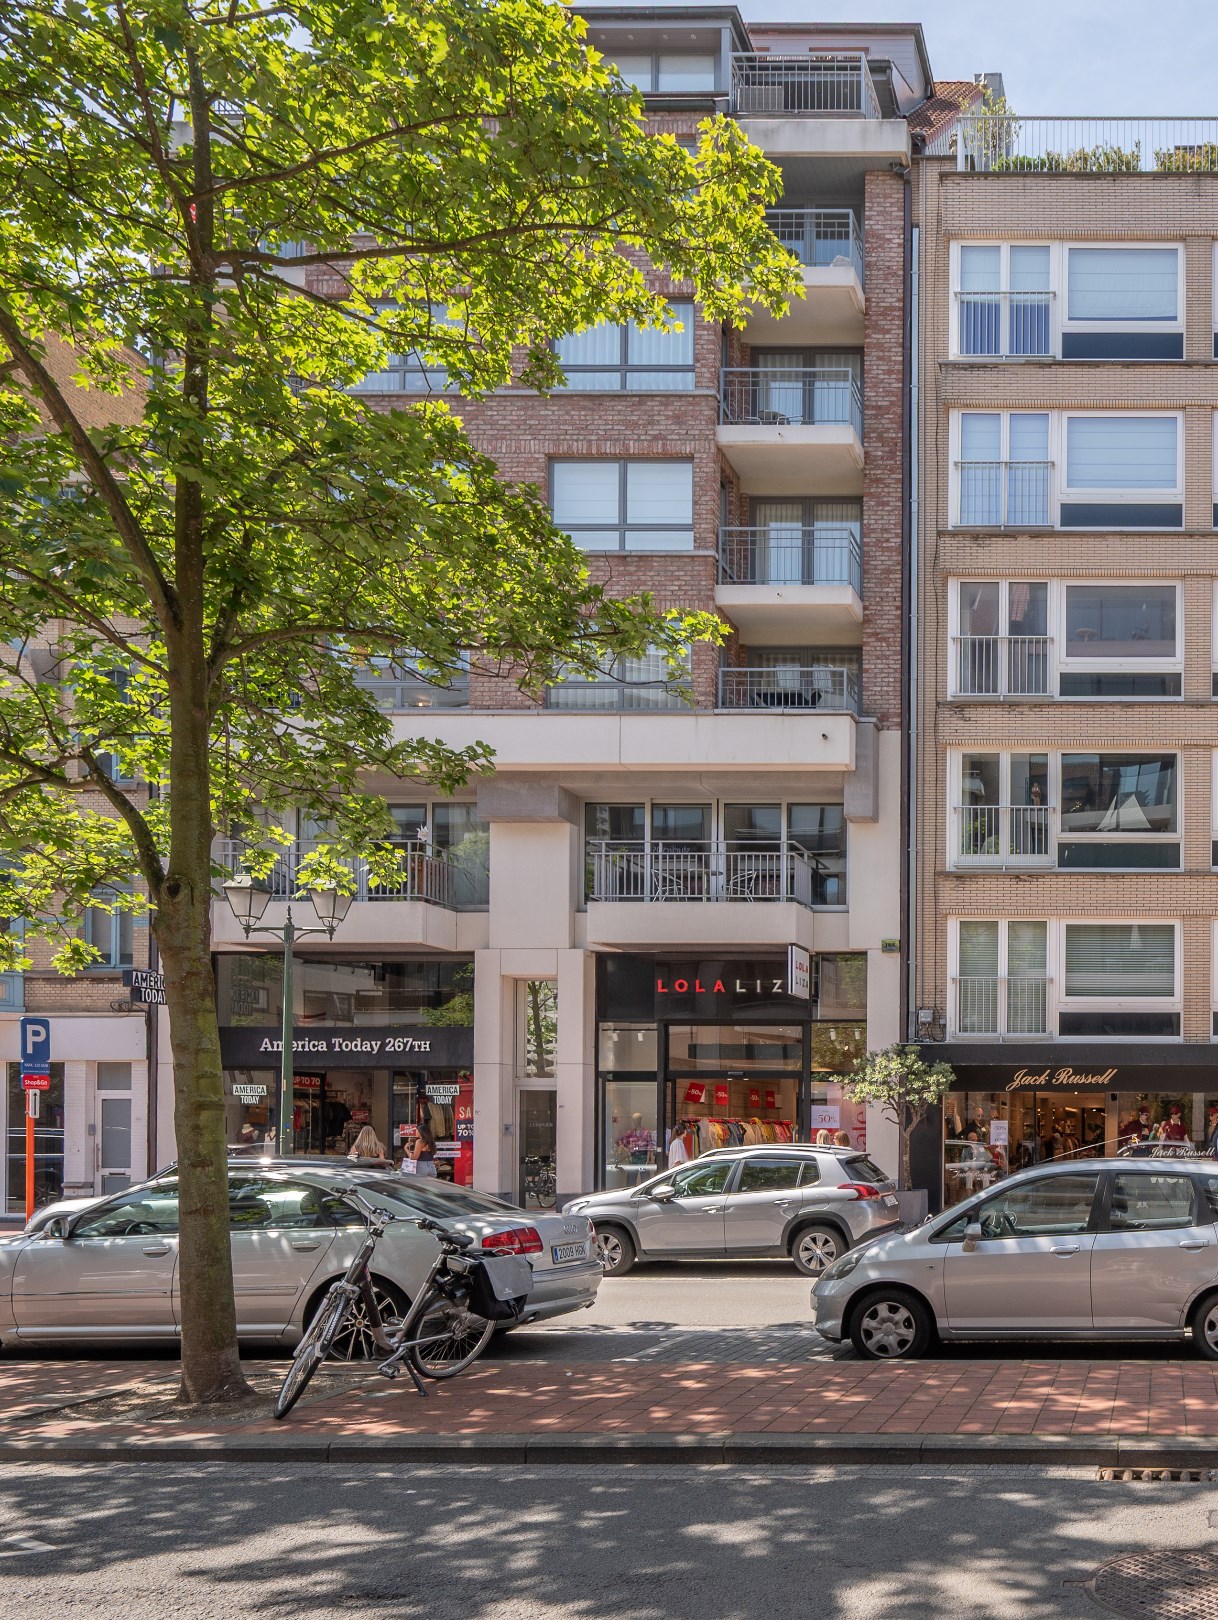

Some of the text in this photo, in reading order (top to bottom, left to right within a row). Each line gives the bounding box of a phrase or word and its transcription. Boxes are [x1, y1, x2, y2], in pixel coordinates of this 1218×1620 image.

[27, 1025, 46, 1054] P
[332, 1038, 381, 1053] Today
[1006, 1067, 1118, 1091] Jack Russell
[234, 1086, 265, 1094] AMERICA
[427, 1086, 458, 1094] AMERICA
[240, 1096, 260, 1104] TODAY
[433, 1096, 453, 1104] TODAY
[1149, 1147, 1216, 1158] Jack Russell
